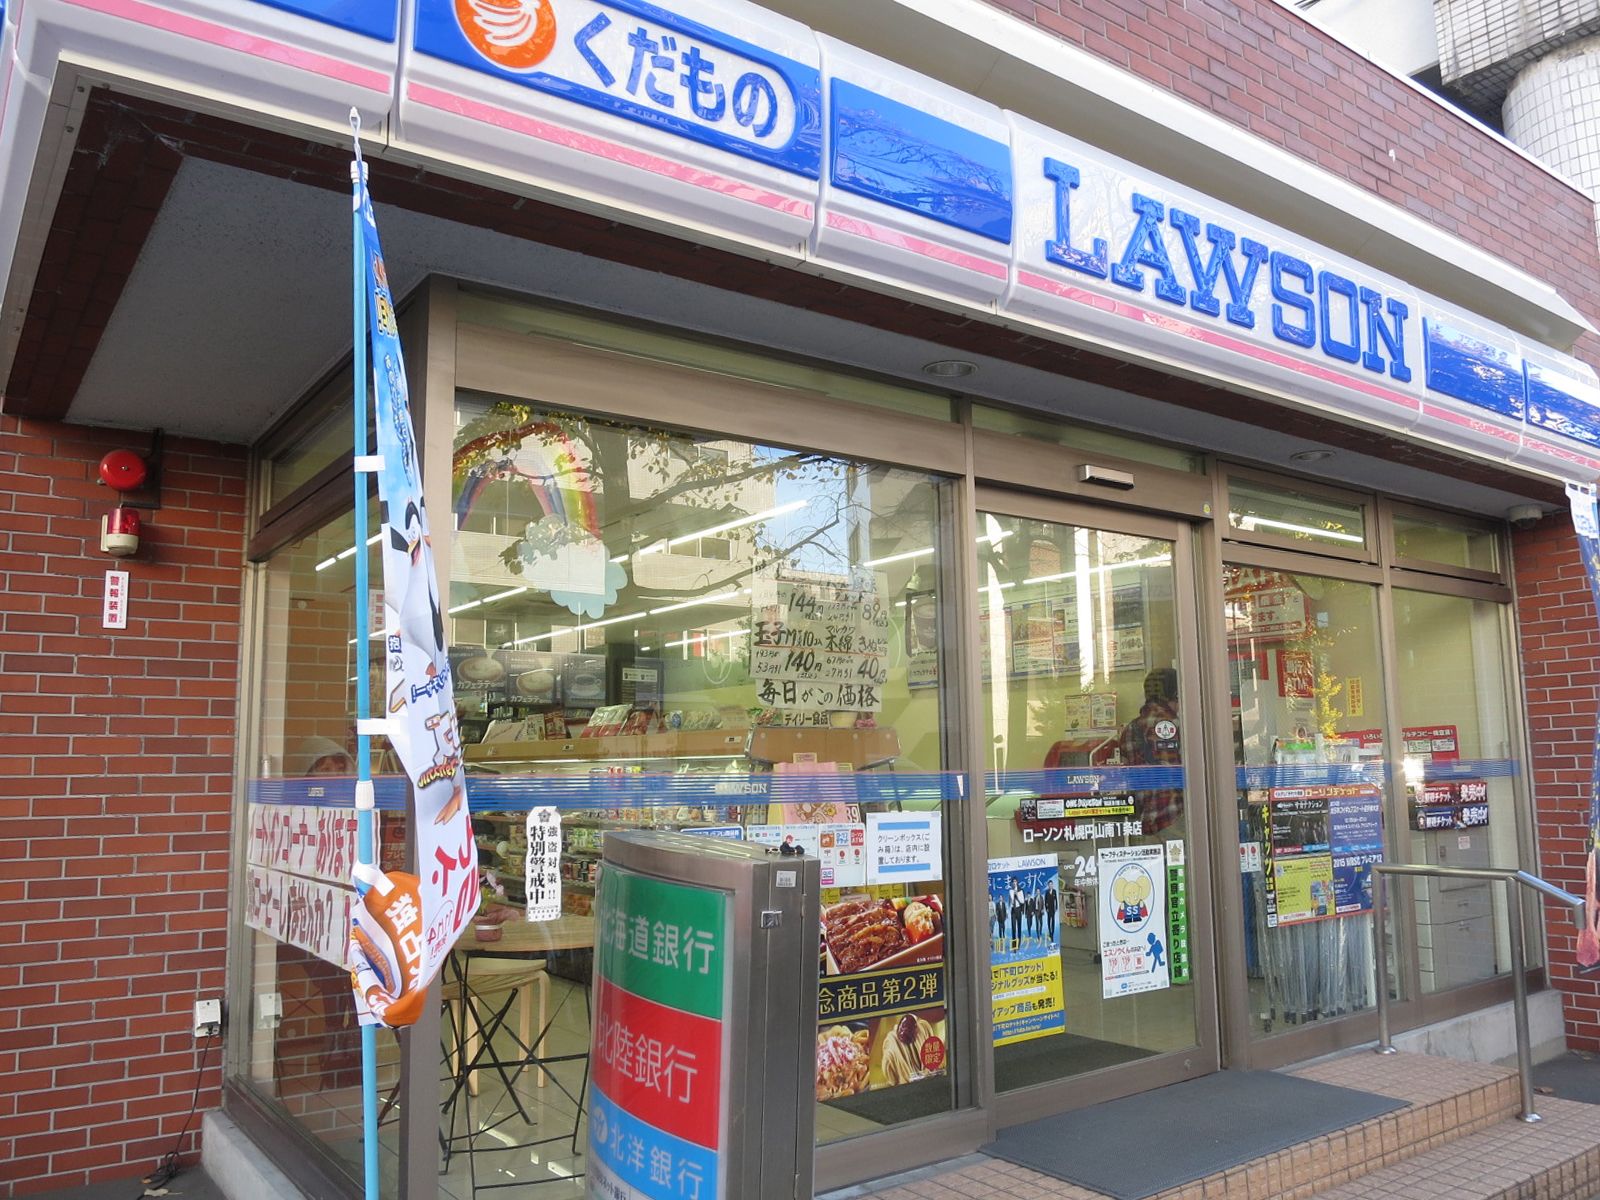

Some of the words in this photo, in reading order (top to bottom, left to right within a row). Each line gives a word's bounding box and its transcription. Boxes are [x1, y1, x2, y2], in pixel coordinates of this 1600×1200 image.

[573, 11, 779, 138] くだもの
[1043, 157, 1412, 384] LAWSON
[757, 678, 881, 708] 毎日がこの価格
[1067, 775, 1101, 784] LAWSON
[529, 825, 546, 904] 特別警戒中
[1017, 858, 1046, 868] LAWSON
[1074, 855, 1097, 878] 24
[1126, 905, 1139, 916] SS
[819, 973, 938, 1016] 念商品第2弾
[597, 1011, 698, 1104] 北陸銀行
[610, 1122, 704, 1200] 北洋銀行
